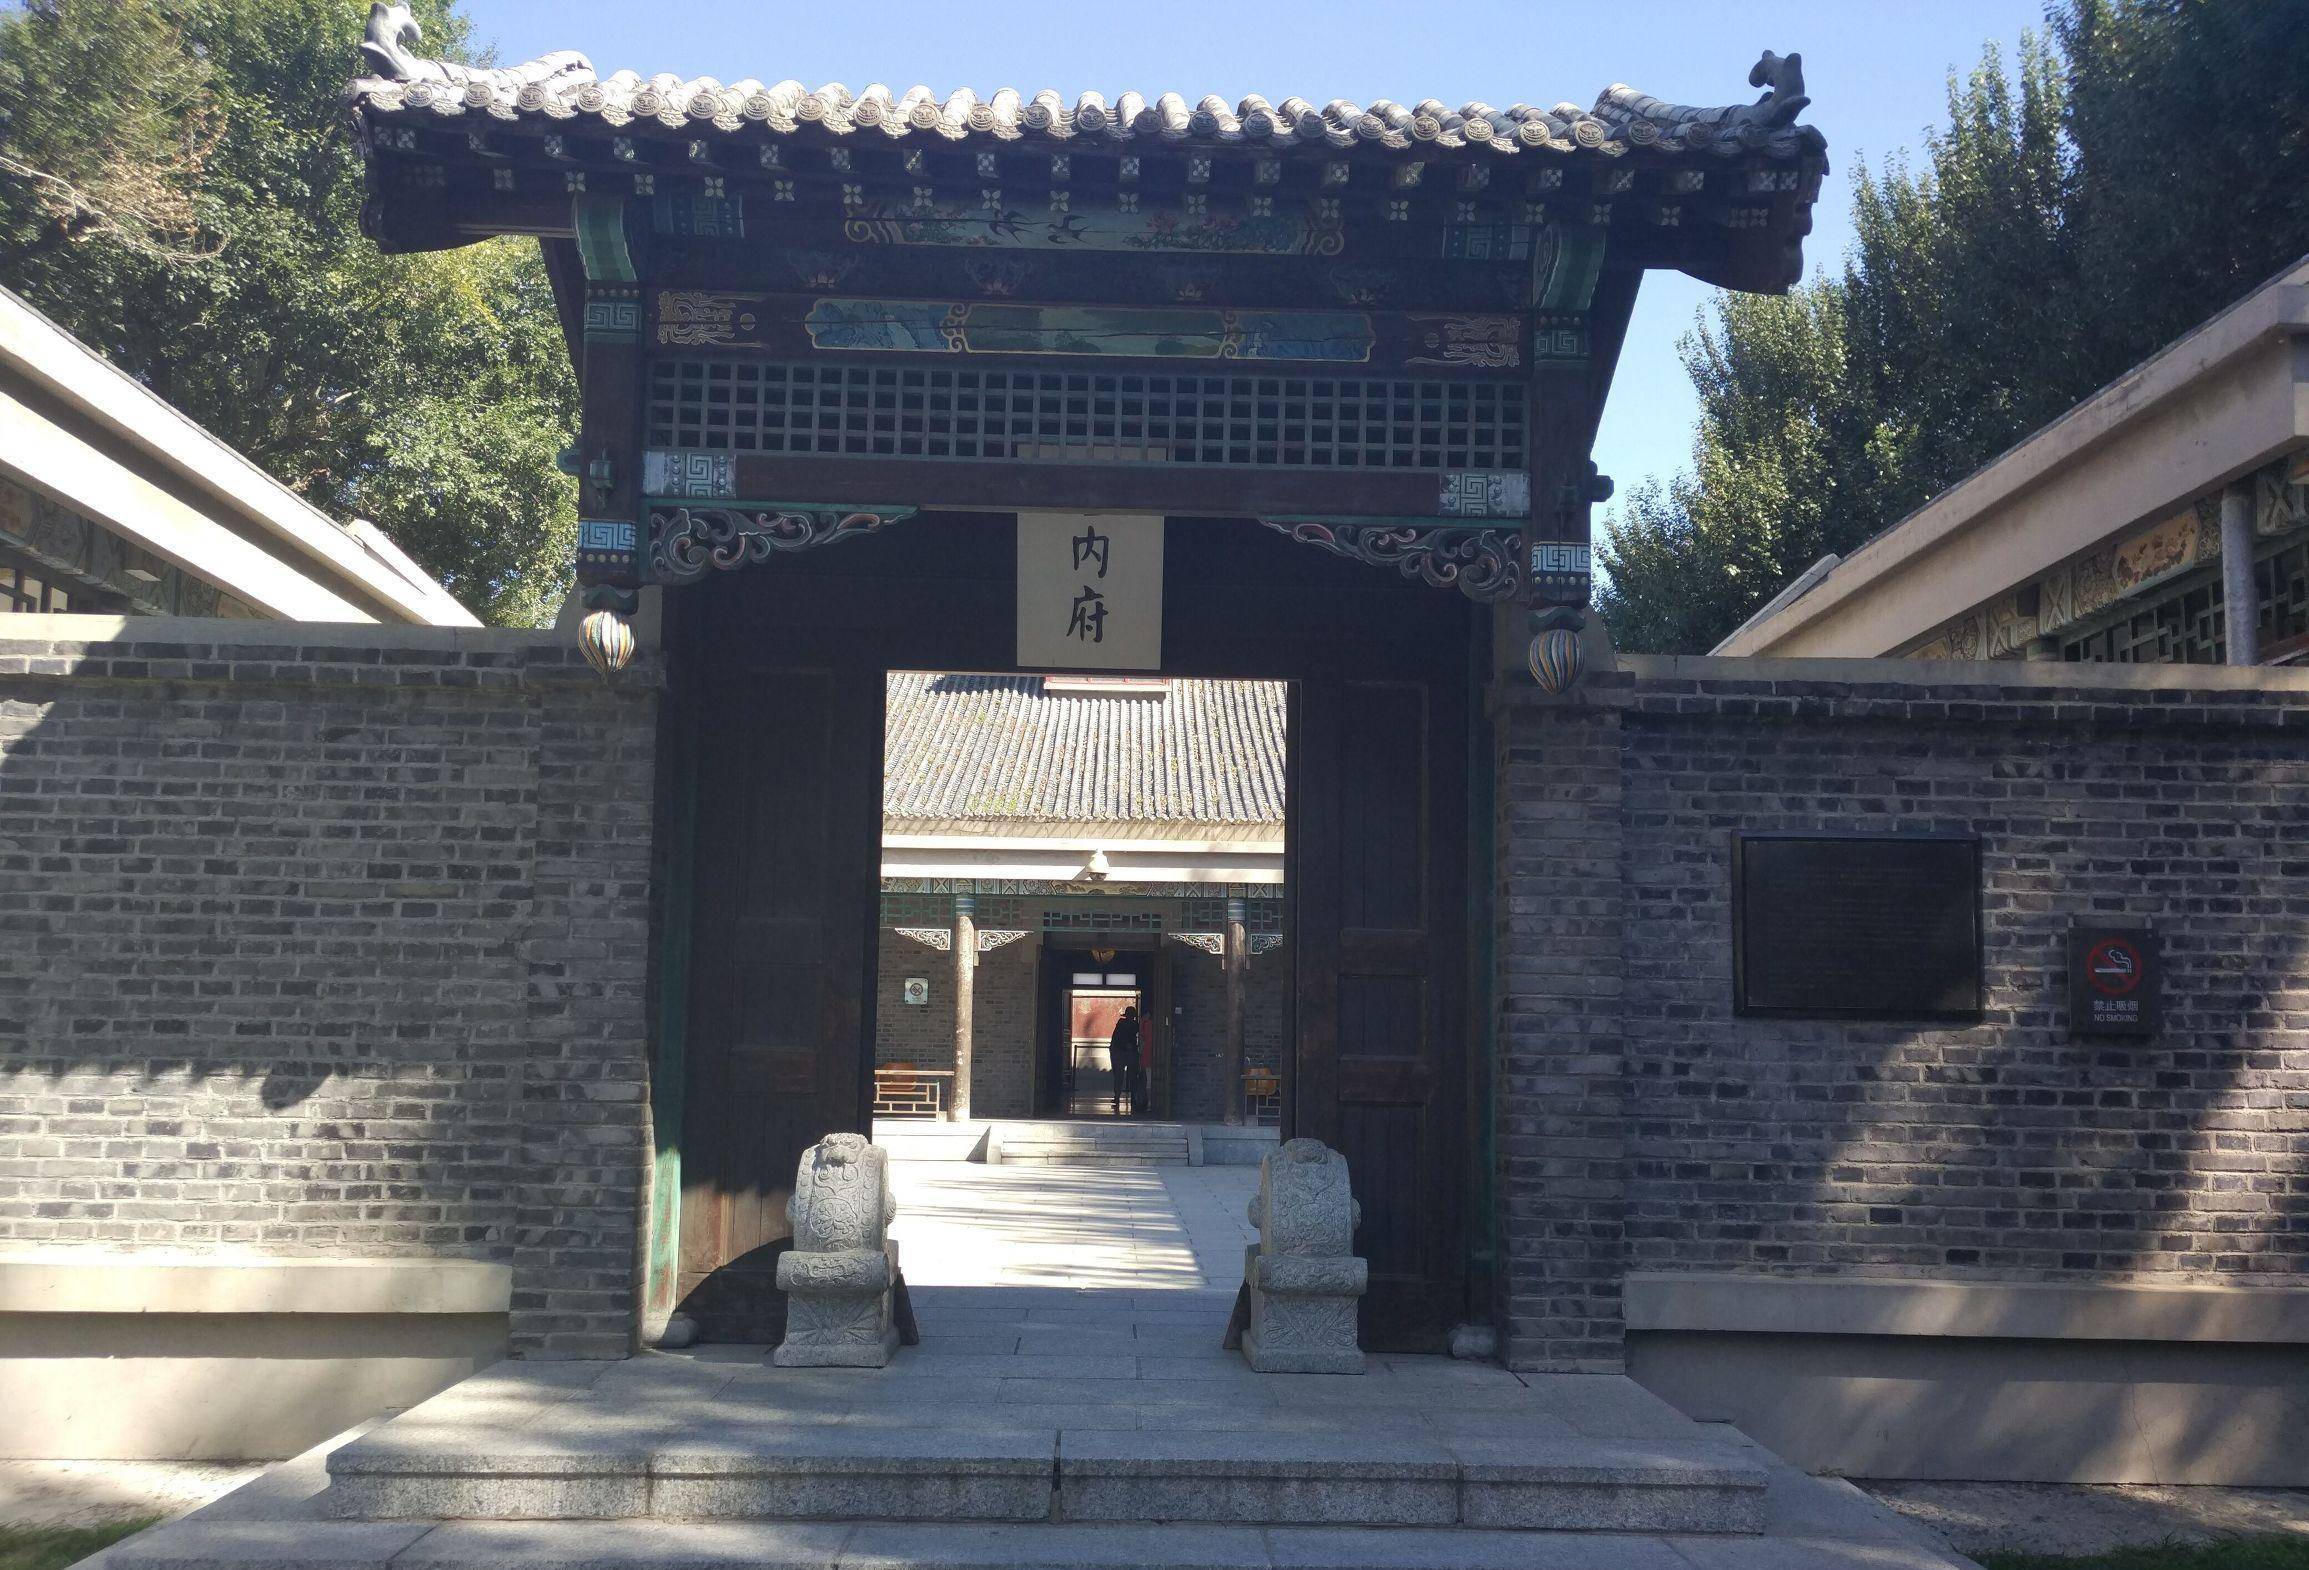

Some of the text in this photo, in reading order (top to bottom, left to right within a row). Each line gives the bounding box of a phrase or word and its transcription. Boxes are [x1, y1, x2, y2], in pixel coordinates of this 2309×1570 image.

[1066, 525, 1109, 643] 内府
[2093, 1000, 2139, 1011] 禁止吸烟
[2094, 1014, 2138, 1022] NO SMOKING
